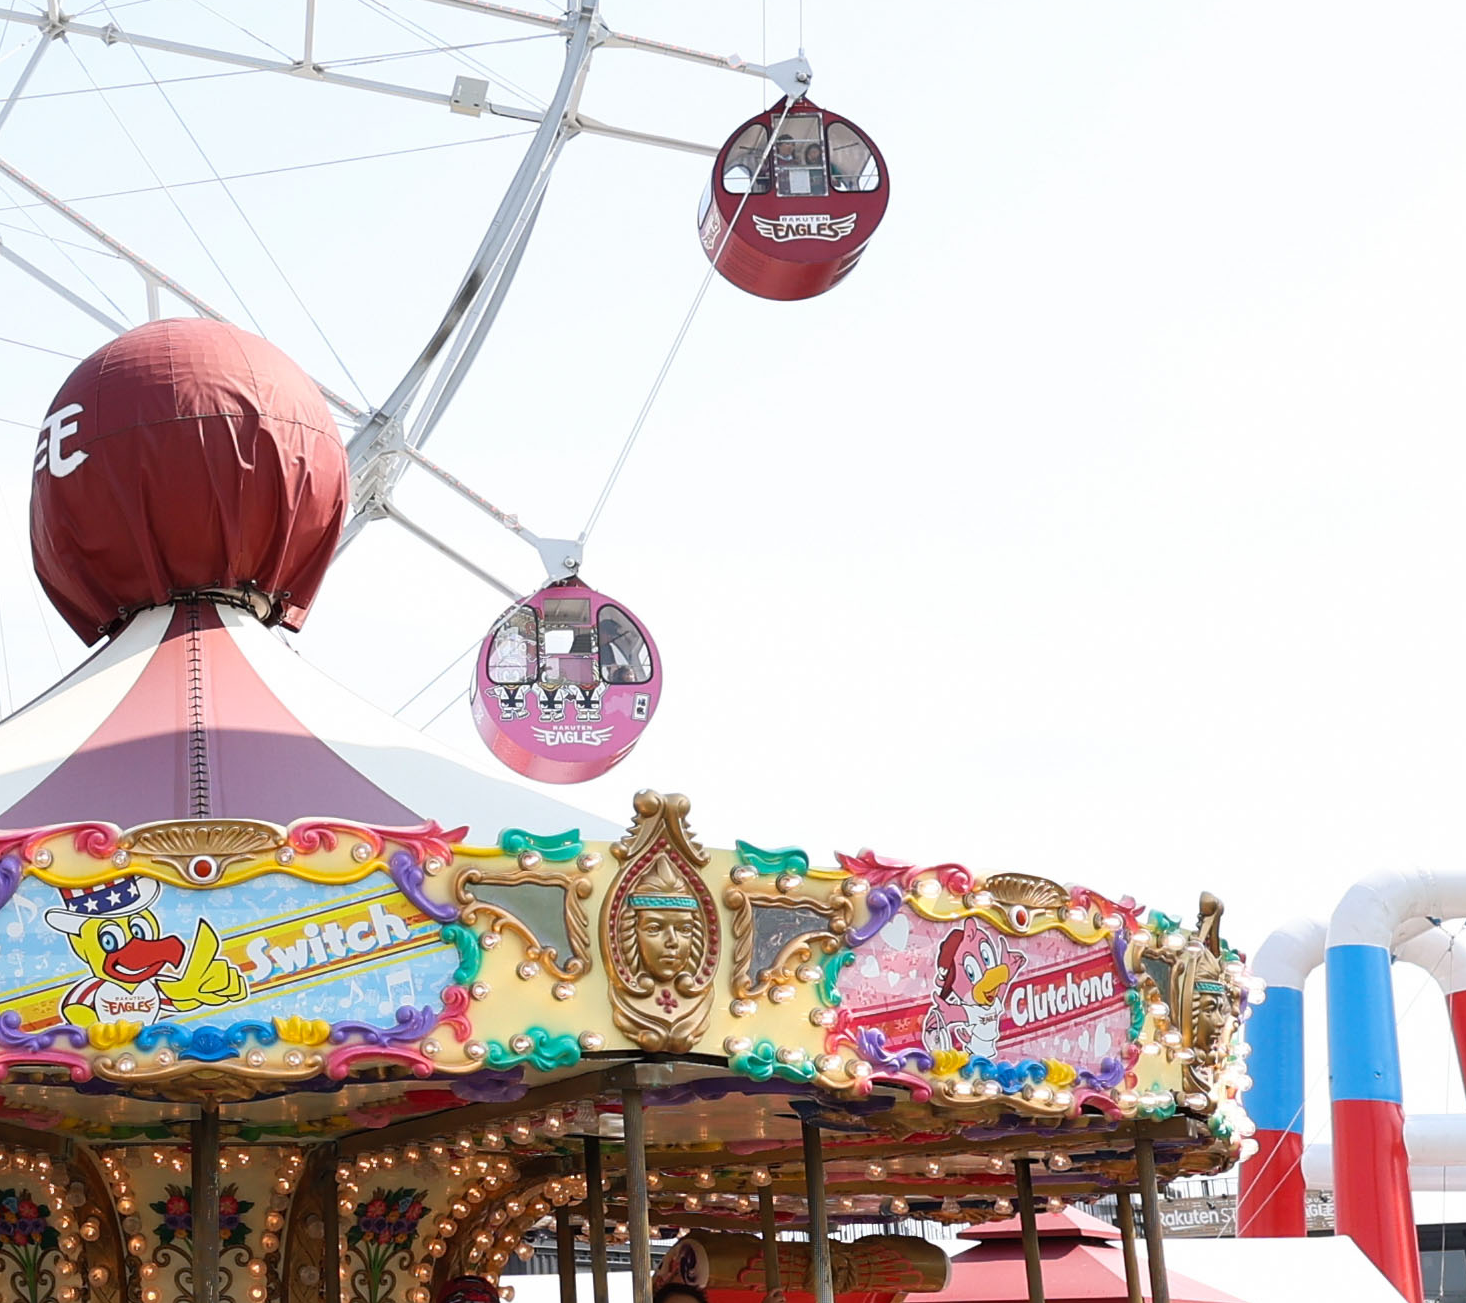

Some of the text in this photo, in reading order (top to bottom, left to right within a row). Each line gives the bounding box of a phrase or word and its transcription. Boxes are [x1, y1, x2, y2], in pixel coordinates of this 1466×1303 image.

[772, 222, 840, 239] EAGLES
[545, 730, 602, 746] EAGLES
[247, 903, 411, 980] Switch
[109, 1000, 152, 1015] EAGLES
[1010, 972, 1113, 1026] Clutchena
[1159, 1209, 1219, 1227] Rakuten
